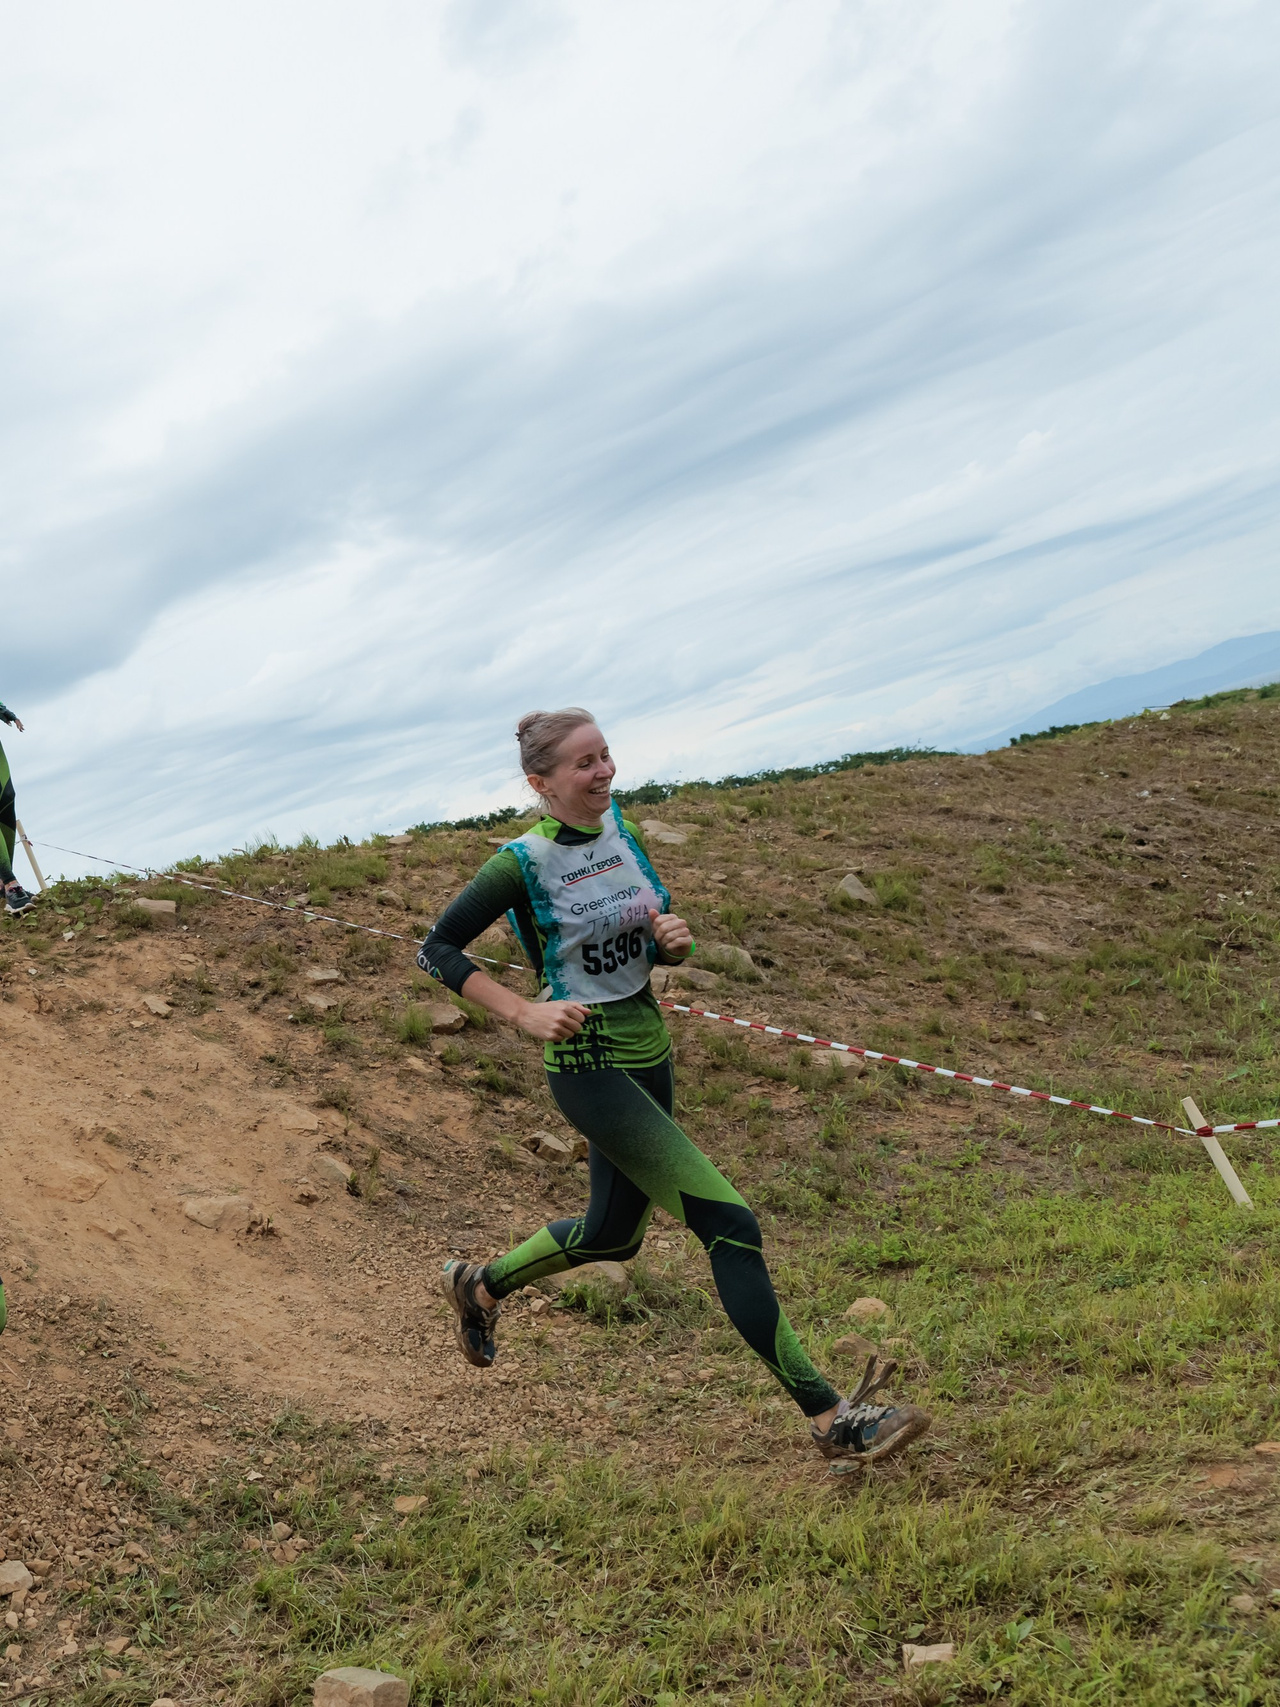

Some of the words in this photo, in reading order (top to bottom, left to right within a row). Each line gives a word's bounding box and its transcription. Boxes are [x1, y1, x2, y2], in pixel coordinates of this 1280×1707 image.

[561, 866, 591, 883] ГОНКА
[592, 854, 623, 873] ГЕРОЕВ
[571, 887, 633, 915] Greenway
[587, 904, 650, 936] ТАТЬЯНА
[582, 926, 644, 976] 5596
